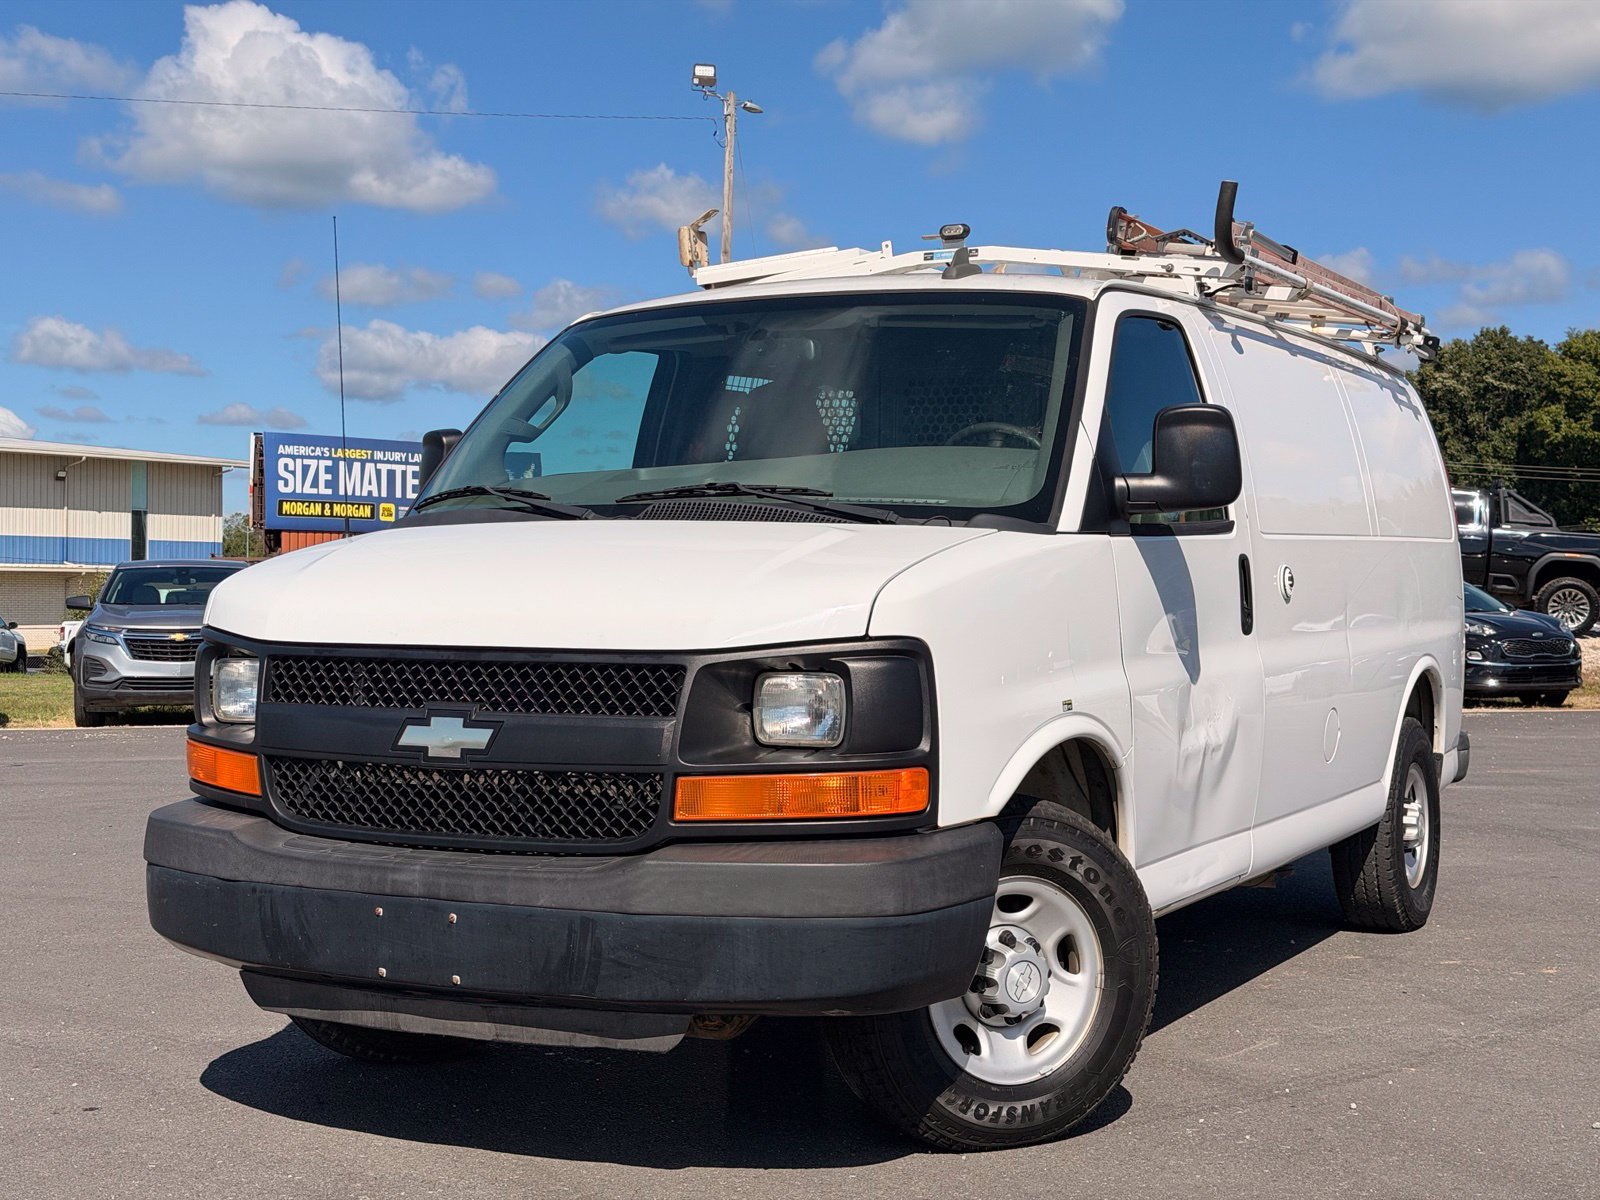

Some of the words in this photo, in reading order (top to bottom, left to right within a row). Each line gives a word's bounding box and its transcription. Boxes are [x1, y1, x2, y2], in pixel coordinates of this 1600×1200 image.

[278, 444, 330, 457] AMERICA'S
[331, 448, 372, 459] LARGEST
[374, 450, 407, 462] INJURY
[408, 452, 422, 462] LA
[278, 457, 333, 495] SIZE
[339, 460, 420, 499] MATTE
[282, 501, 322, 516] MORGAN
[324, 503, 331, 516] &
[333, 503, 371, 518] MORGAN
